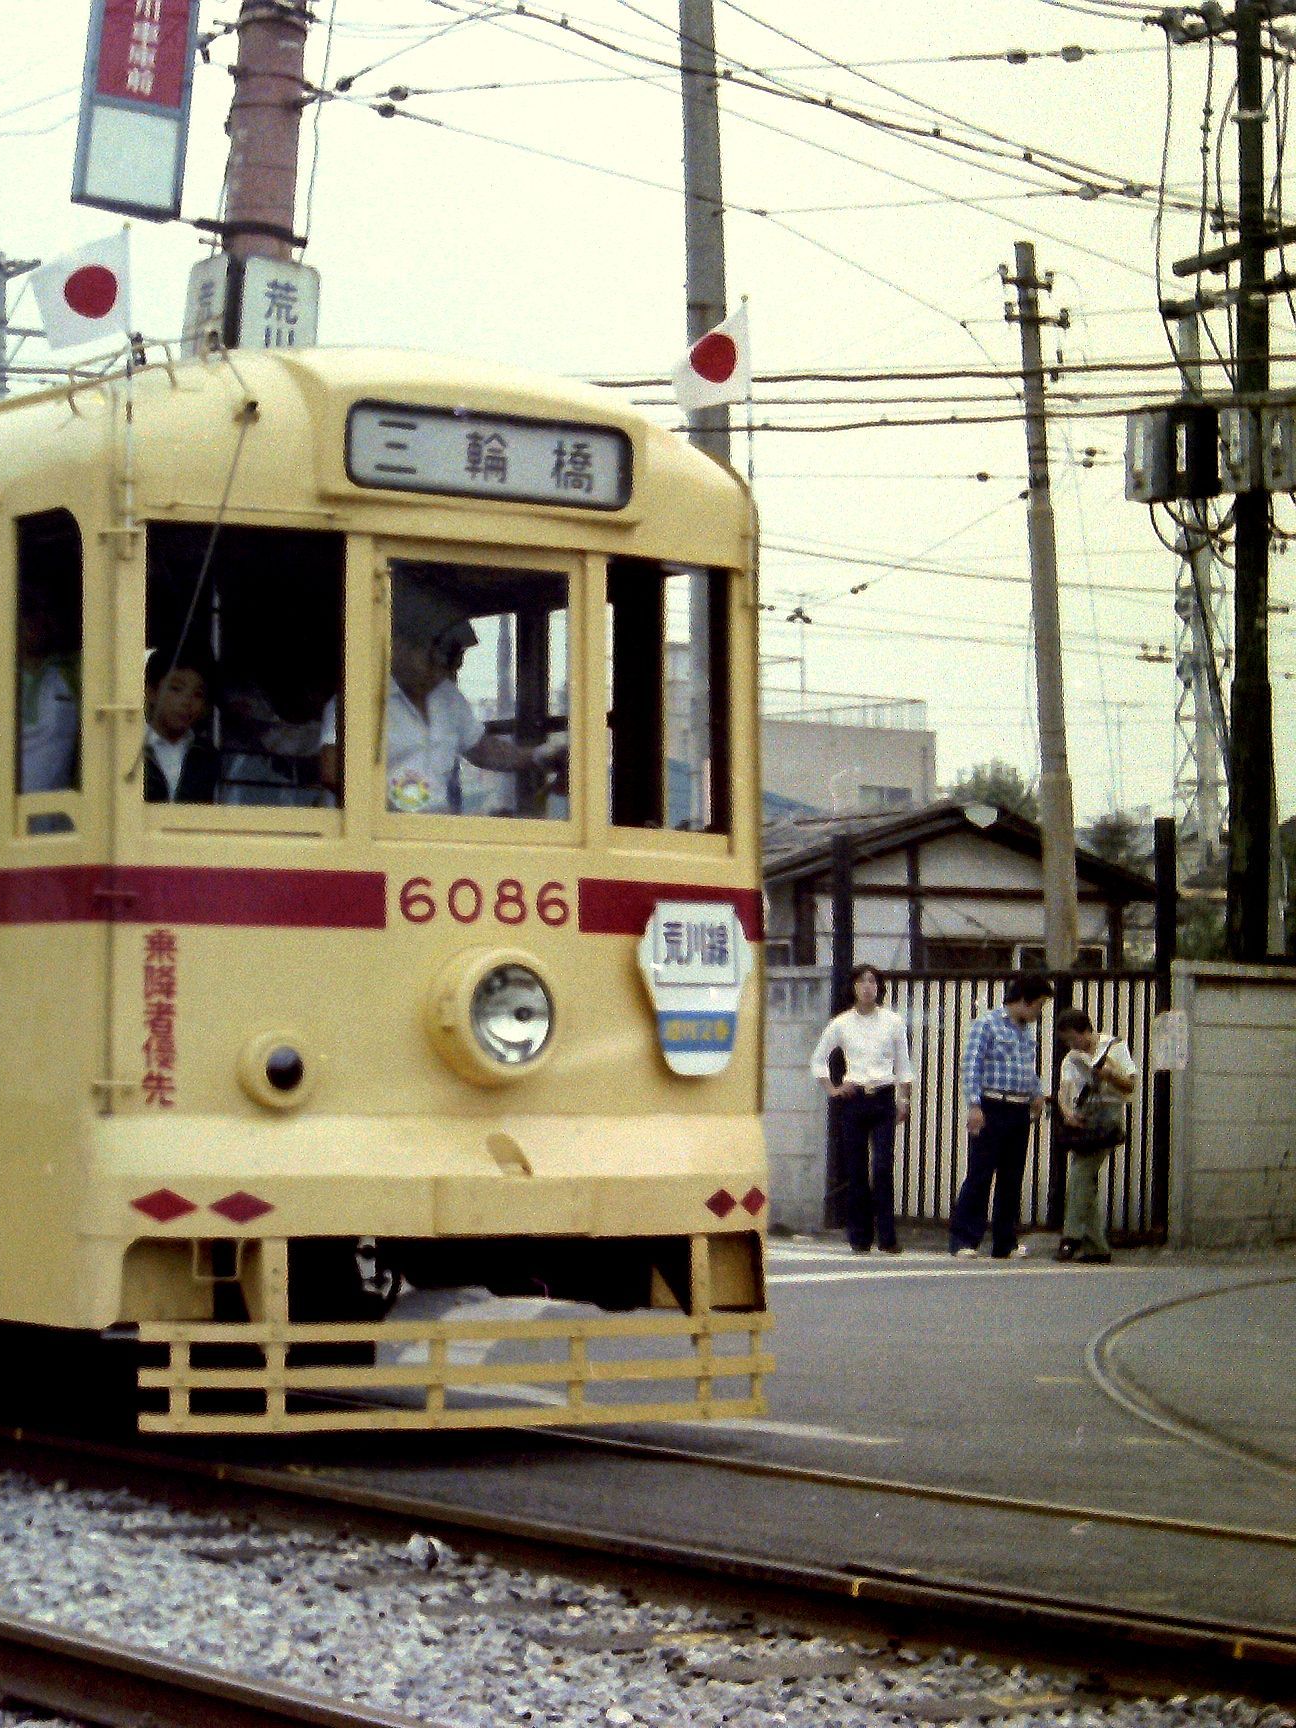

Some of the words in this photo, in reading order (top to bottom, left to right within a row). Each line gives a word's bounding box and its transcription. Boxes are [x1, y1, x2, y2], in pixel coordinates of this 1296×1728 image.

[374, 419, 593, 493] 三輪橋
[399, 876, 571, 927] 6086
